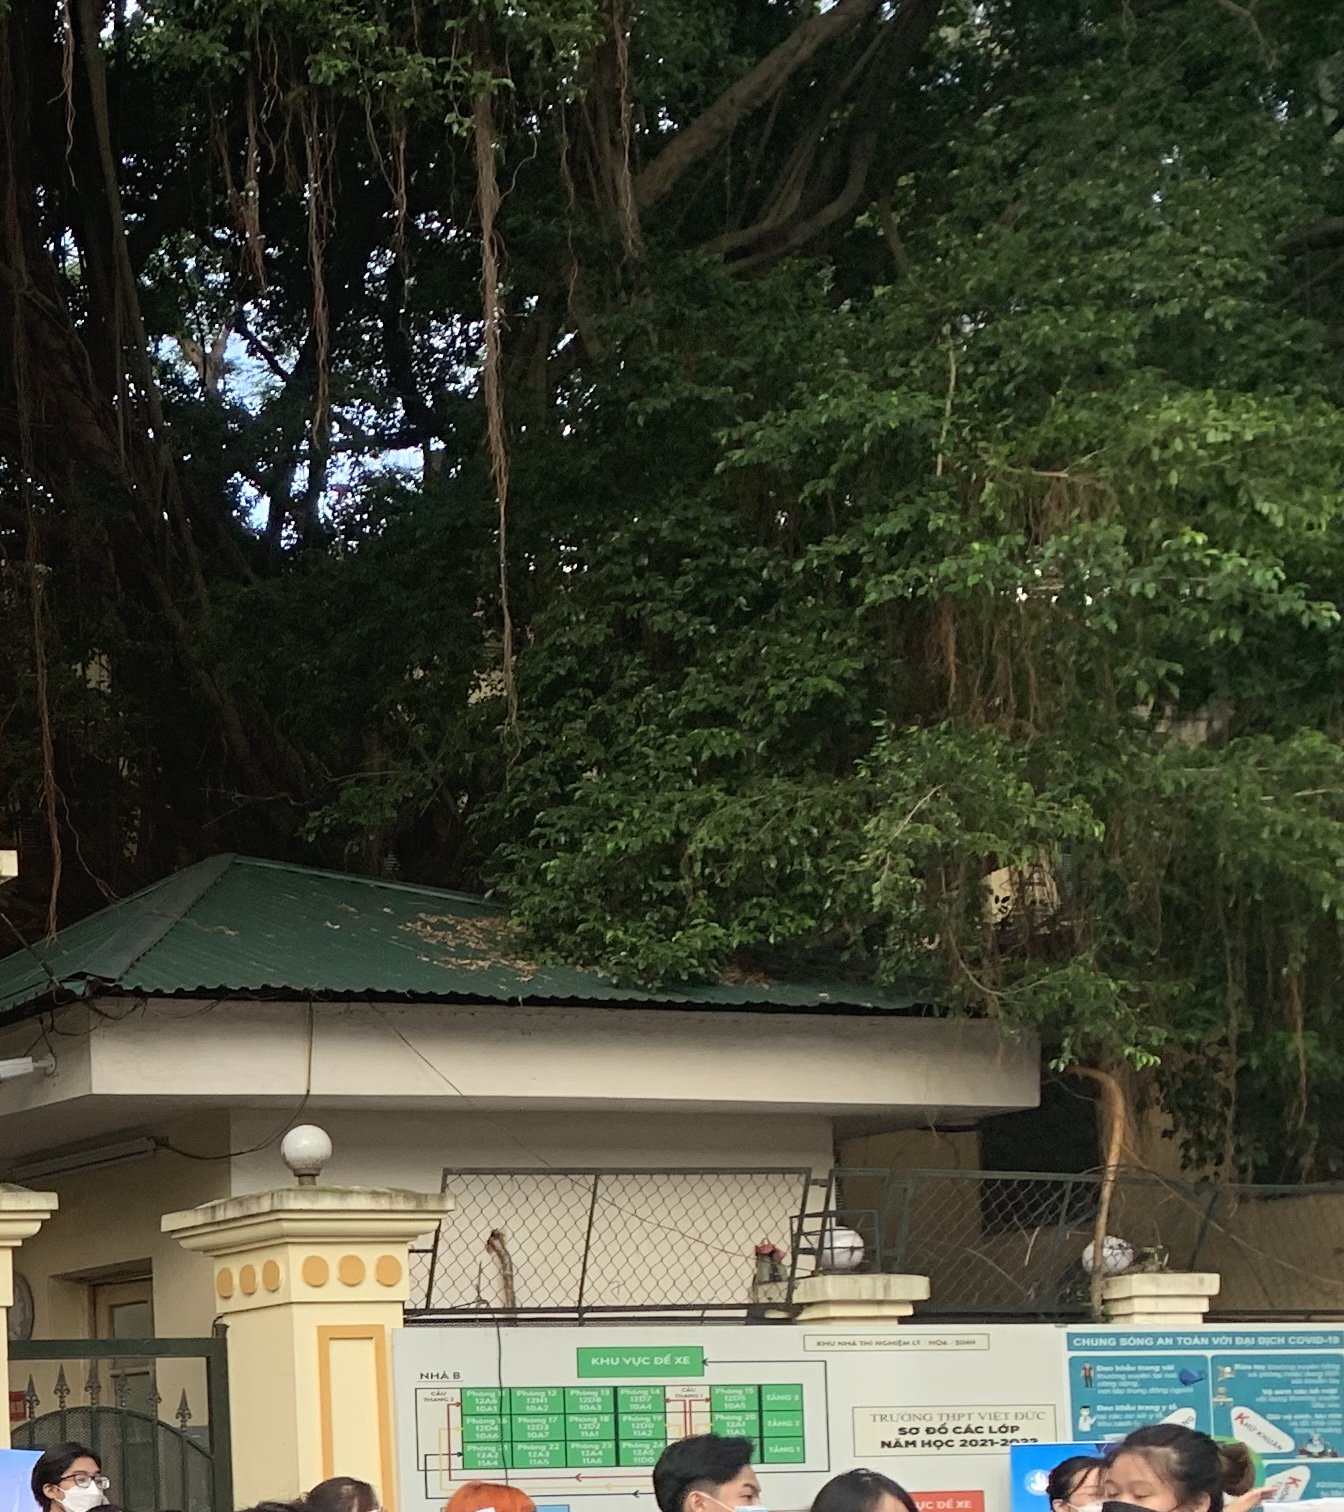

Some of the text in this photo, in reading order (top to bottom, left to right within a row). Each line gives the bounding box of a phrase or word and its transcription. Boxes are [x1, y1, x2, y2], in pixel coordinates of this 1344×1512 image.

[1073, 1337, 1116, 1347] CHUNG
[1156, 1337, 1175, 1346] AN
[1177, 1336, 1209, 1346] TOÀN
[1288, 1336, 1340, 1345] COVID-19
[592, 1357, 619, 1365] KHU
[622, 1357, 651, 1367] VỰC
[674, 1357, 690, 1365] XE
[420, 1371, 449, 1380] NHÀ
[938, 1411, 975, 1422] THPT
[977, 1411, 1011, 1422] VIỆT
[898, 1424, 920, 1435] SƠ
[953, 1424, 983, 1435] CÁC
[988, 1422, 1020, 1434] LỚP
[880, 1437, 916, 1449] NĂM
[921, 1438, 954, 1450] HỌC
[916, 1500, 934, 1511] ỰC
[956, 1500, 972, 1509] XE
